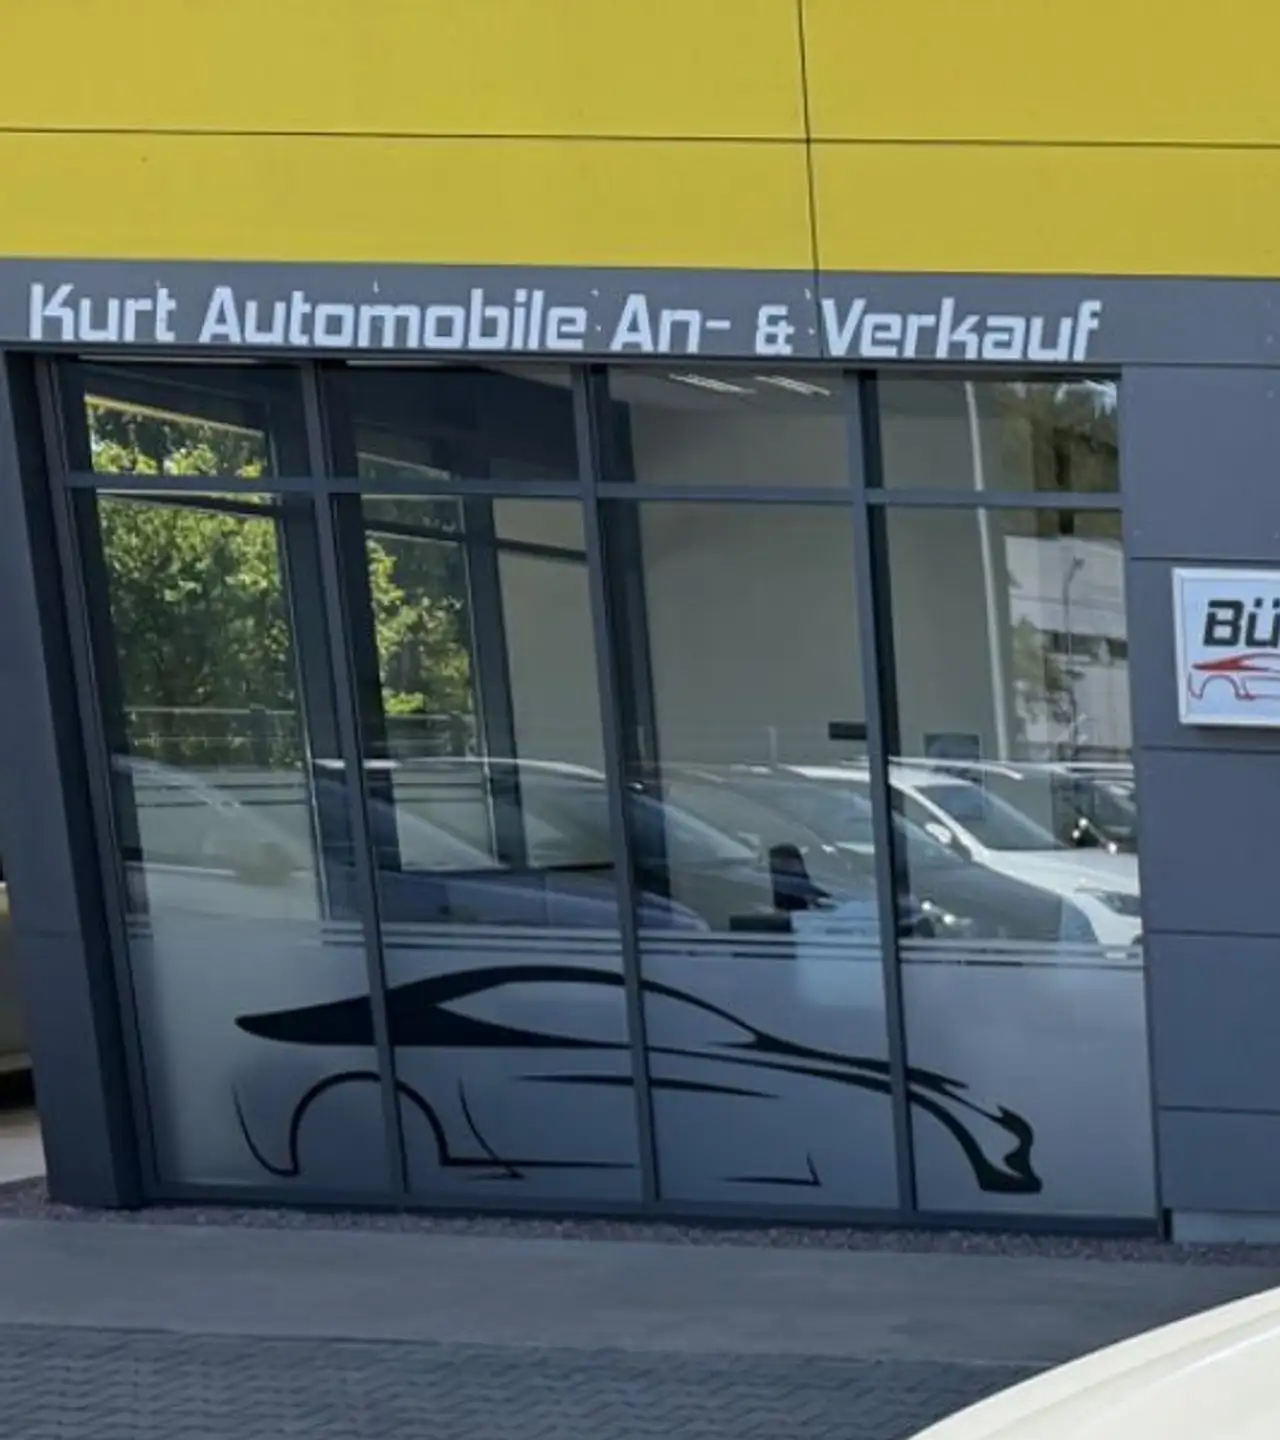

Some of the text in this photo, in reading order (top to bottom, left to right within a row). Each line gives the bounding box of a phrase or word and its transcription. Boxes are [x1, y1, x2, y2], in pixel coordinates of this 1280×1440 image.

[29, 283, 1103, 361] Kurt Automobile An- & Verkauf
